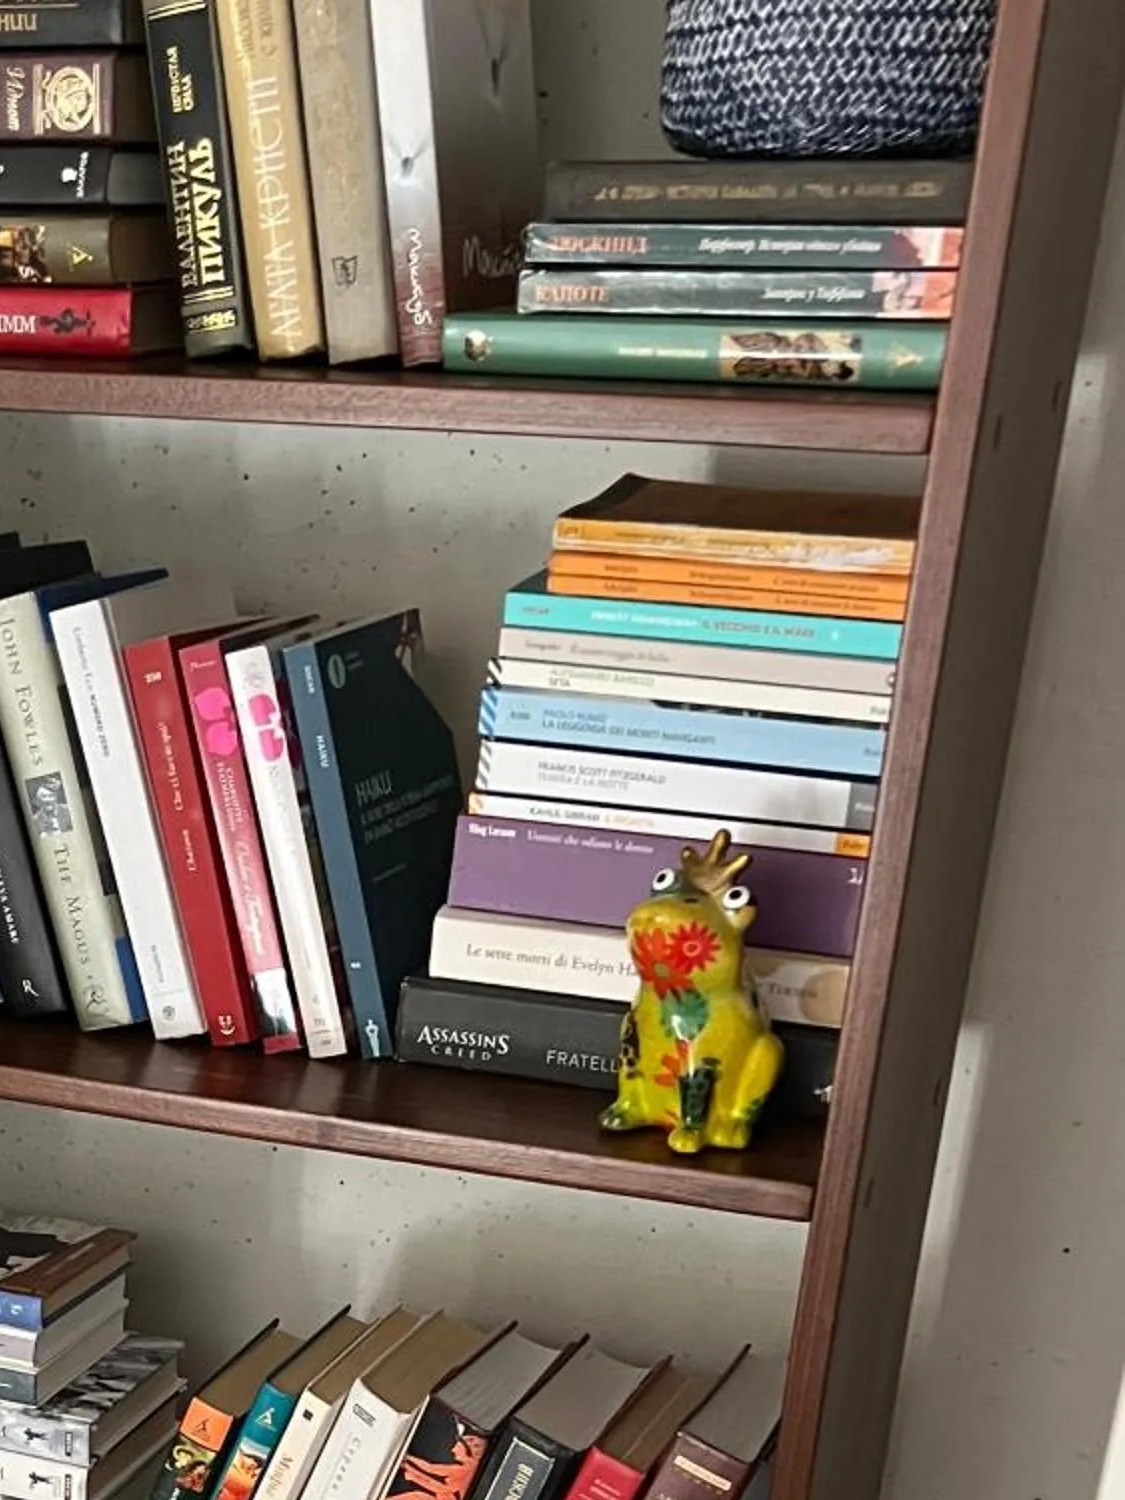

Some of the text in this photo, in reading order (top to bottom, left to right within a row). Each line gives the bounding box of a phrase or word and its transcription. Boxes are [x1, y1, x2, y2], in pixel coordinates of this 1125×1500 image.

[167, 141, 196, 289] ВАЛЕНТИН
[187, 137, 226, 286] ПИКУЛЬ
[12, 683, 49, 767] FOWLES
[52, 843, 95, 965] THE MAGUS
[465, 942, 482, 957] Le
[483, 946, 513, 961] sette
[515, 950, 552, 967] morti
[553, 952, 569, 967] di
[570, 955, 614, 977] Evelyn
[328, 1434, 363, 1491] Страна
